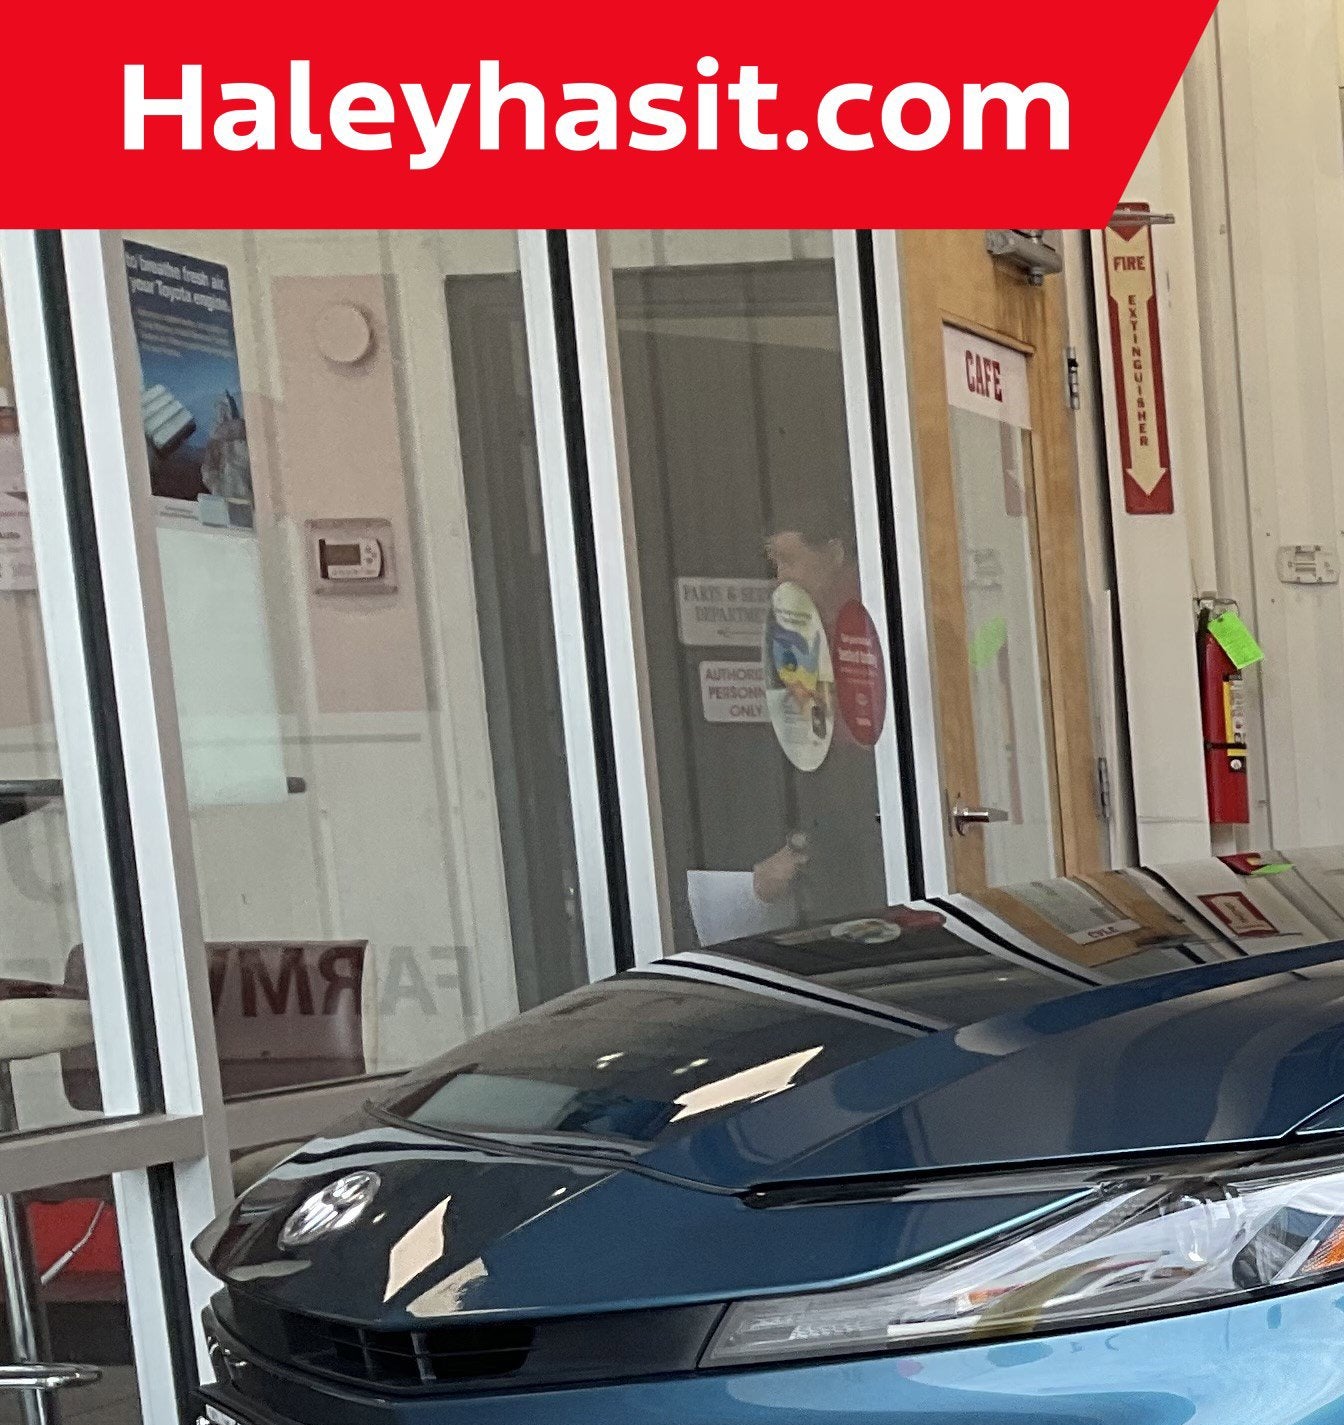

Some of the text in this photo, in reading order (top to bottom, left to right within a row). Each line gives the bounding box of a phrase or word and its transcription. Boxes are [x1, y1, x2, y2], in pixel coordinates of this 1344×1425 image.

[1113, 256, 1146, 271] FIRE
[964, 350, 1003, 403] CAFE
[1128, 294, 1150, 446] EXTINGUISHER
[729, 703, 763, 718] ONLY
